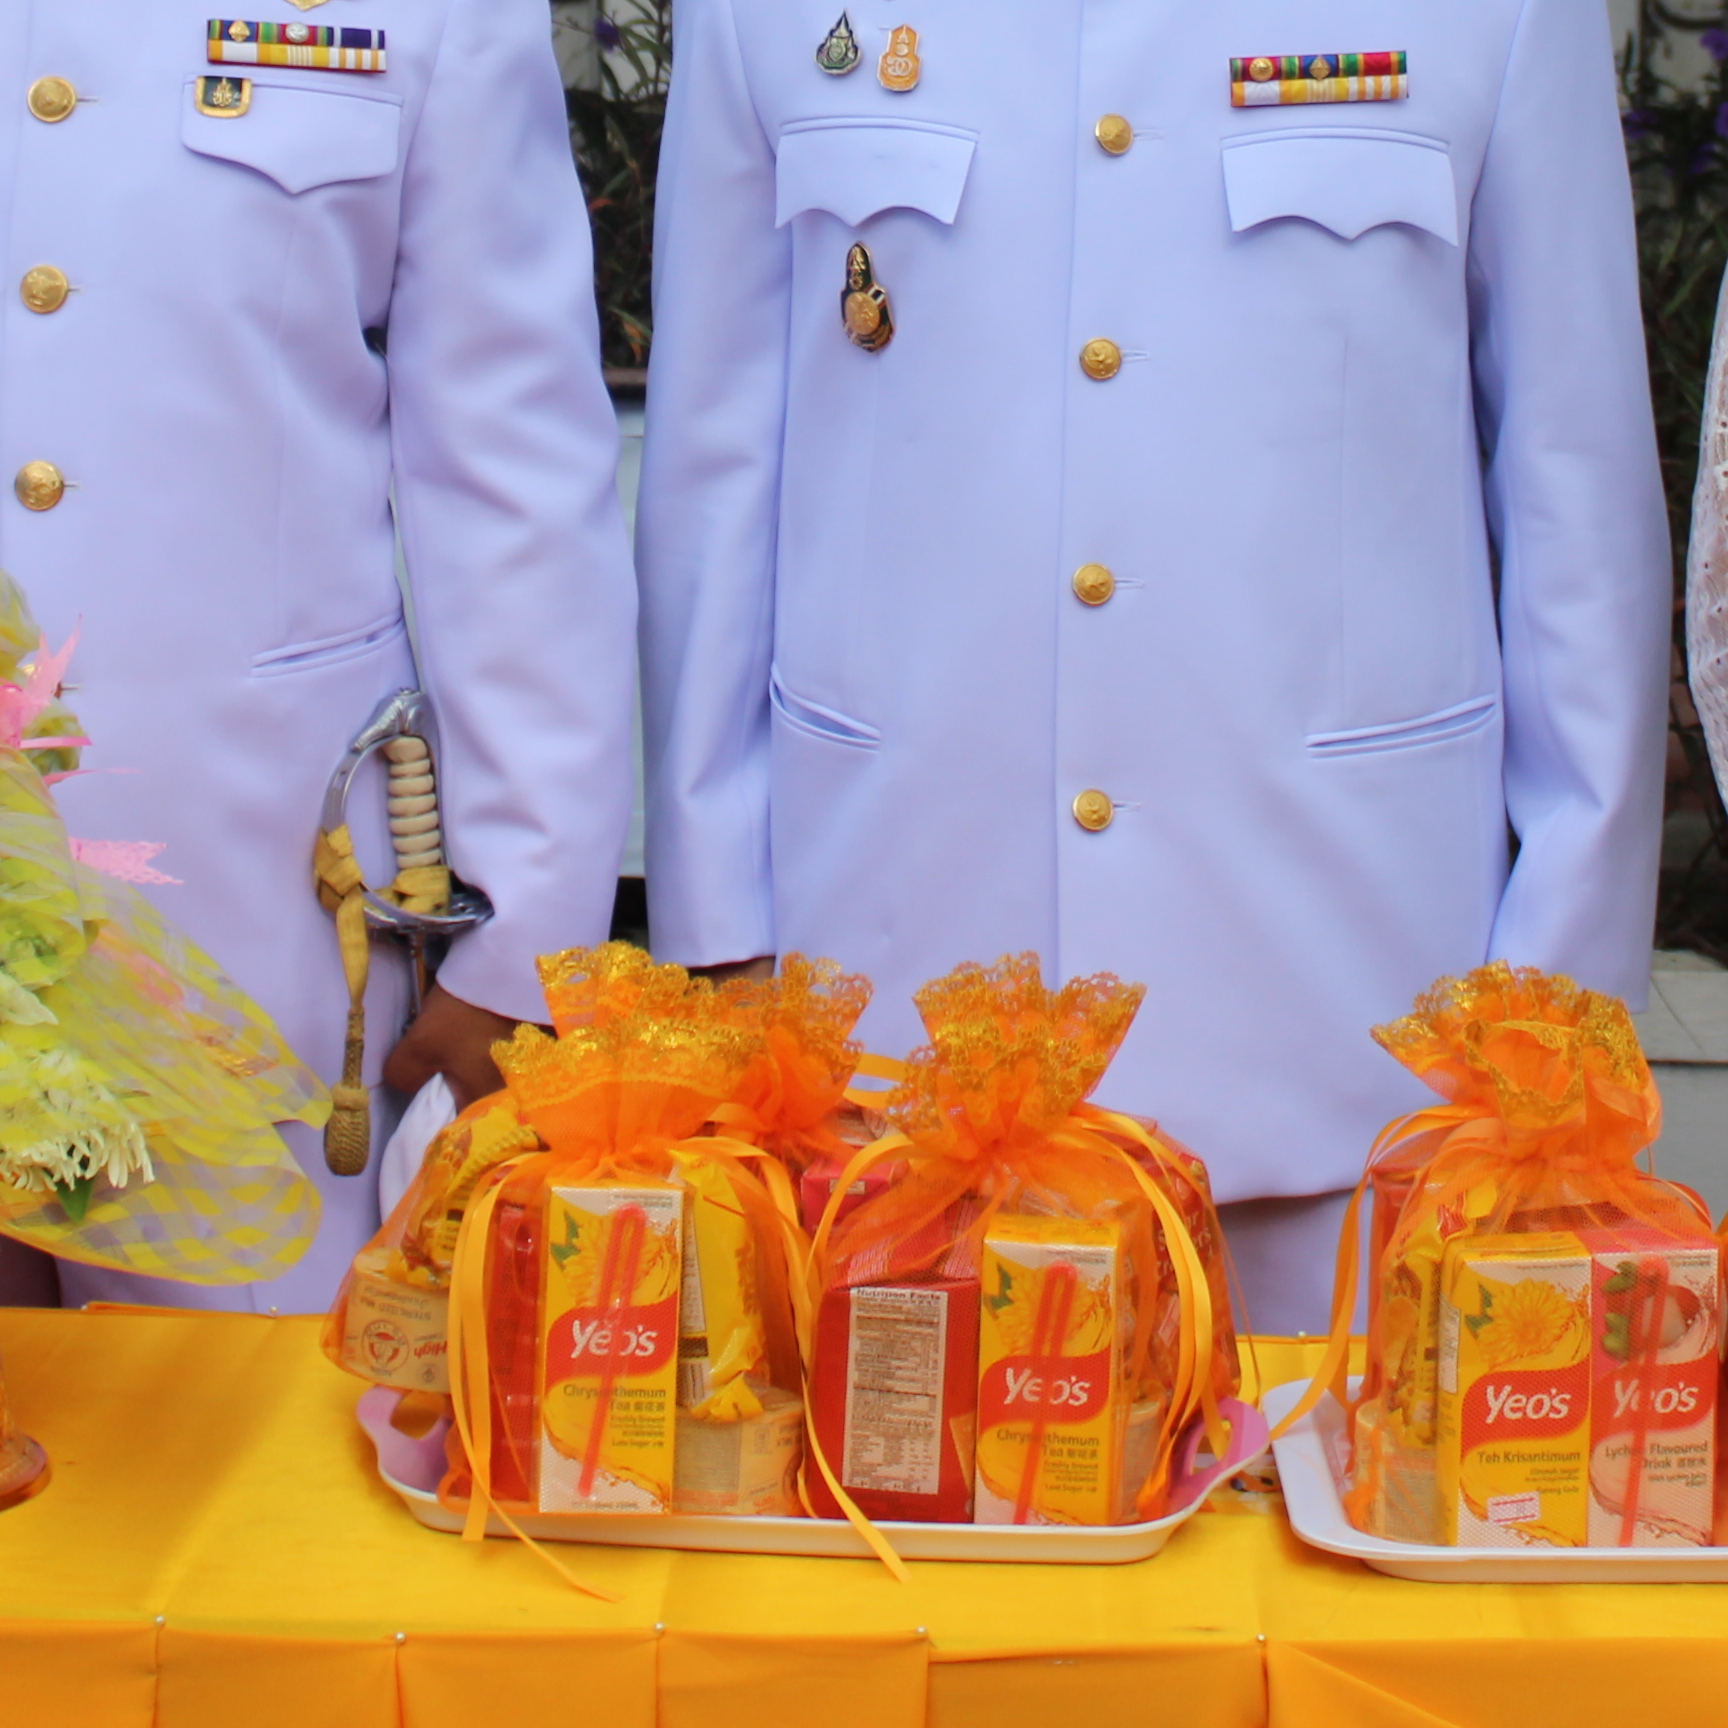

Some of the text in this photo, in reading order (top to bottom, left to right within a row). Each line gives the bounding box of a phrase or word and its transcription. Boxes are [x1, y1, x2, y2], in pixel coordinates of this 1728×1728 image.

[570, 1319, 658, 1359] Yeo's
[563, 1384, 666, 1401] Chrysthemum
[1003, 1367, 1091, 1406] Yeo's
[1485, 1384, 1571, 1424] Yeo's
[1503, 1450, 1581, 1463] Krisantimum
[1650, 1441, 1708, 1456] Flavoured
